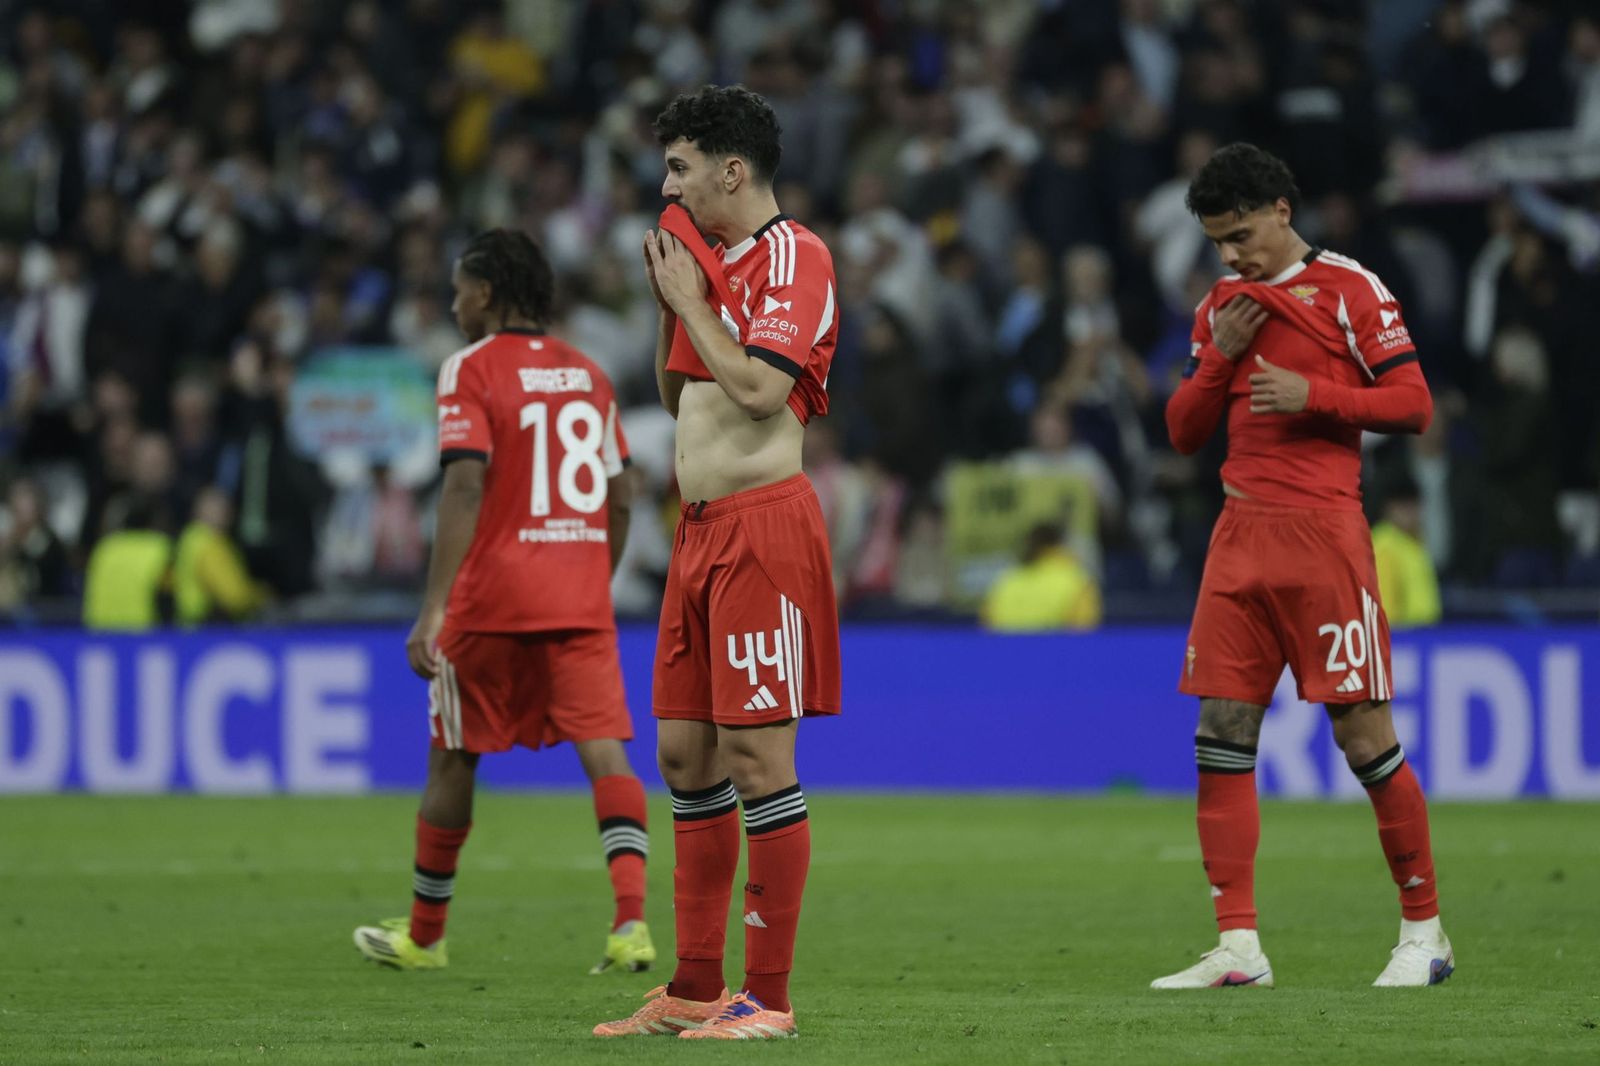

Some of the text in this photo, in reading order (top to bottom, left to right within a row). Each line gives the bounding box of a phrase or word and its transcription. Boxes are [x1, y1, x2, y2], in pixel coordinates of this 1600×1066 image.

[751, 316, 799, 336] kaizen
[520, 400, 608, 517] 18
[727, 629, 786, 686] 44
[1318, 619, 1367, 672] 20
[0, 645, 373, 794] DUCE
